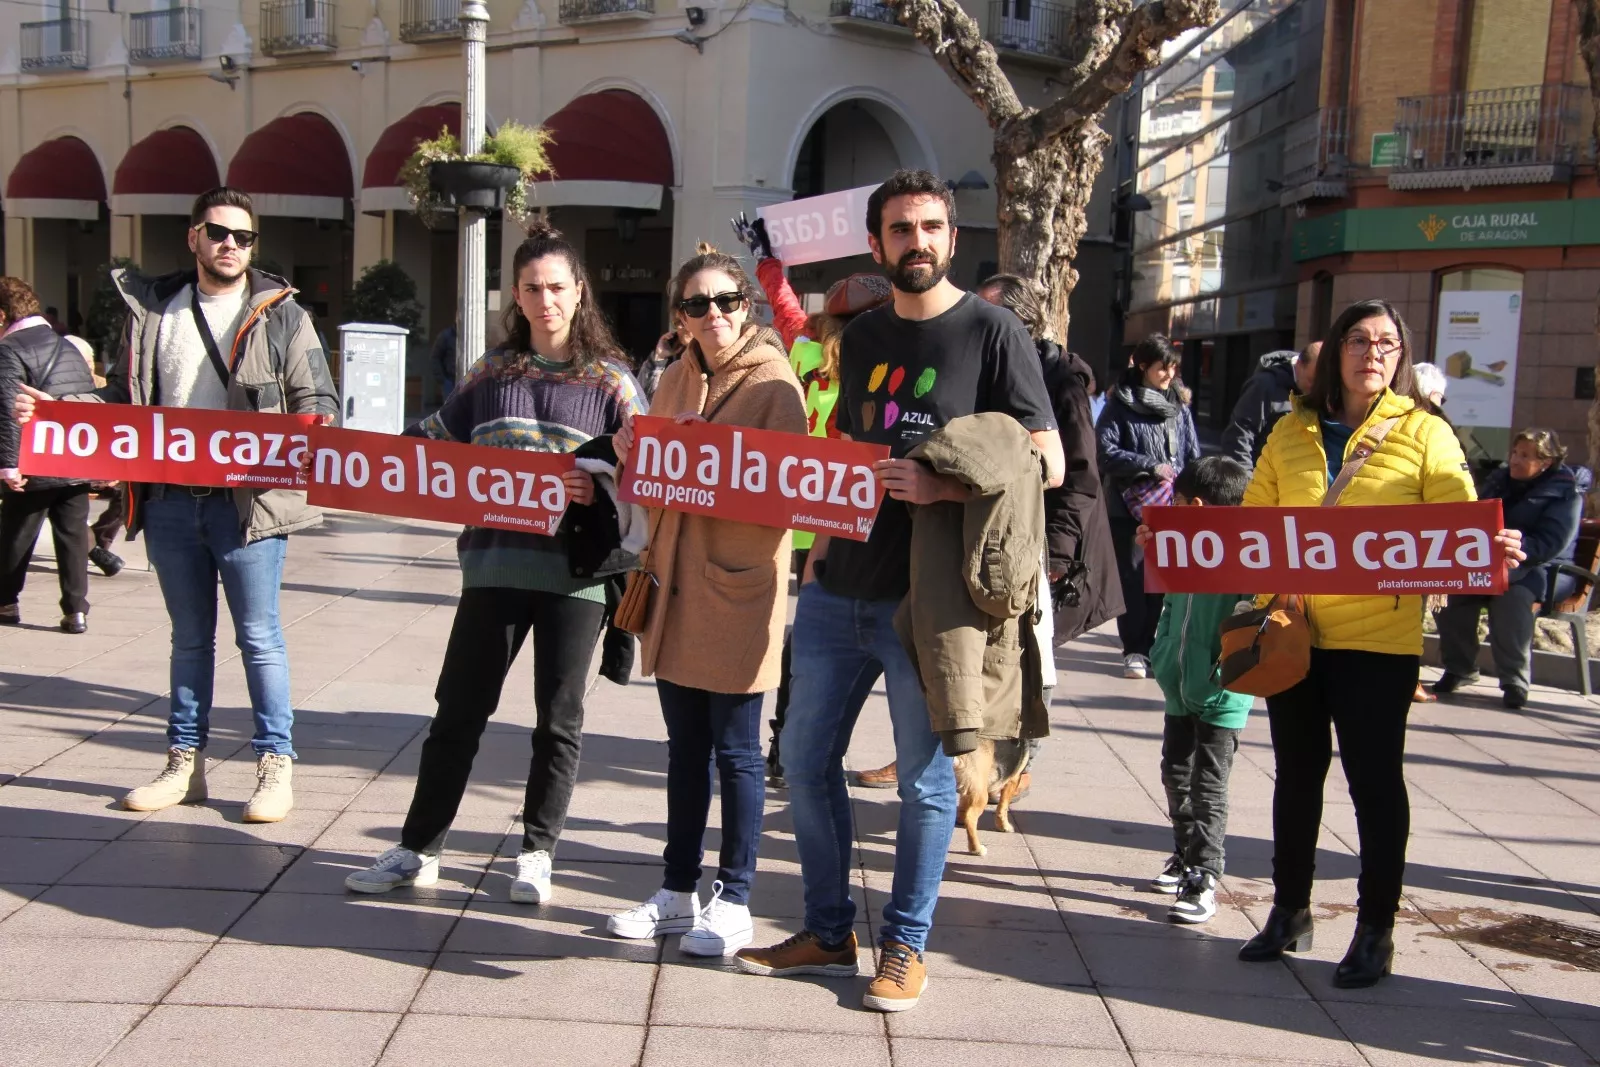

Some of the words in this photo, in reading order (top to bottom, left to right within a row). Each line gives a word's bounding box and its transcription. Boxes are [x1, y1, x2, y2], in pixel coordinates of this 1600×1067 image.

[1452, 215, 1487, 229] CAJA
[1490, 212, 1539, 227] RURAL
[1460, 231, 1475, 242] DE
[1478, 229, 1528, 241] ARAGÓN
[901, 411, 934, 426] AZUL
[33, 420, 99, 457] no
[111, 424, 139, 459] a
[152, 413, 195, 462] la
[209, 429, 308, 468] caza
[226, 472, 292, 486] plataformanac.org
[315, 447, 370, 488] no
[381, 456, 405, 493] a
[415, 444, 456, 498] la
[467, 465, 566, 512] caza
[636, 436, 687, 481] no
[696, 444, 720, 486] a
[730, 431, 767, 493] la
[778, 455, 876, 510] caza
[632, 479, 662, 499] con
[665, 484, 715, 508] perros
[483, 512, 546, 531] plataformanac.org
[792, 513, 854, 534] plataformanac.org
[1155, 529, 1224, 569] no
[1239, 530, 1270, 569] a
[1283, 516, 1337, 569] la
[1352, 527, 1491, 569] caza
[1377, 578, 1463, 590] plataformanac.org
[1467, 572, 1492, 587] NAC
